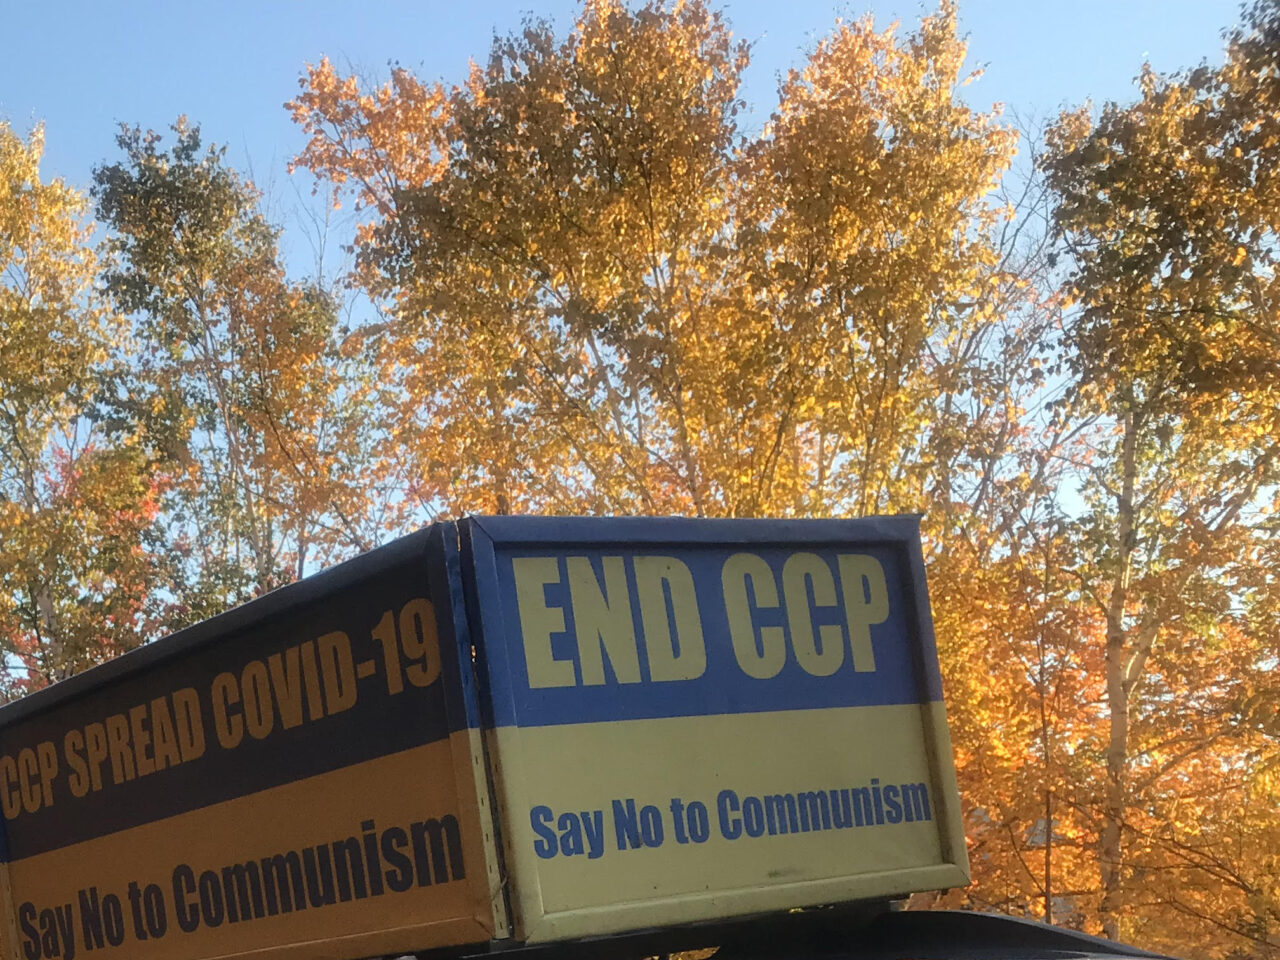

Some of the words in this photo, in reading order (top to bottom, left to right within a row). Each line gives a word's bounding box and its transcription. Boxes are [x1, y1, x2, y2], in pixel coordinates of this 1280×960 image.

[512, 555, 707, 689] END
[721, 552, 890, 680] CCP
[64, 687, 206, 798] SPREAD
[211, 598, 442, 749] COVID-19
[77, 887, 126, 952] No
[128, 880, 168, 941] to
[171, 812, 466, 933] Communism
[530, 804, 604, 860] Say
[611, 798, 664, 851] No
[670, 797, 710, 845] to
[717, 778, 932, 841] Communism
